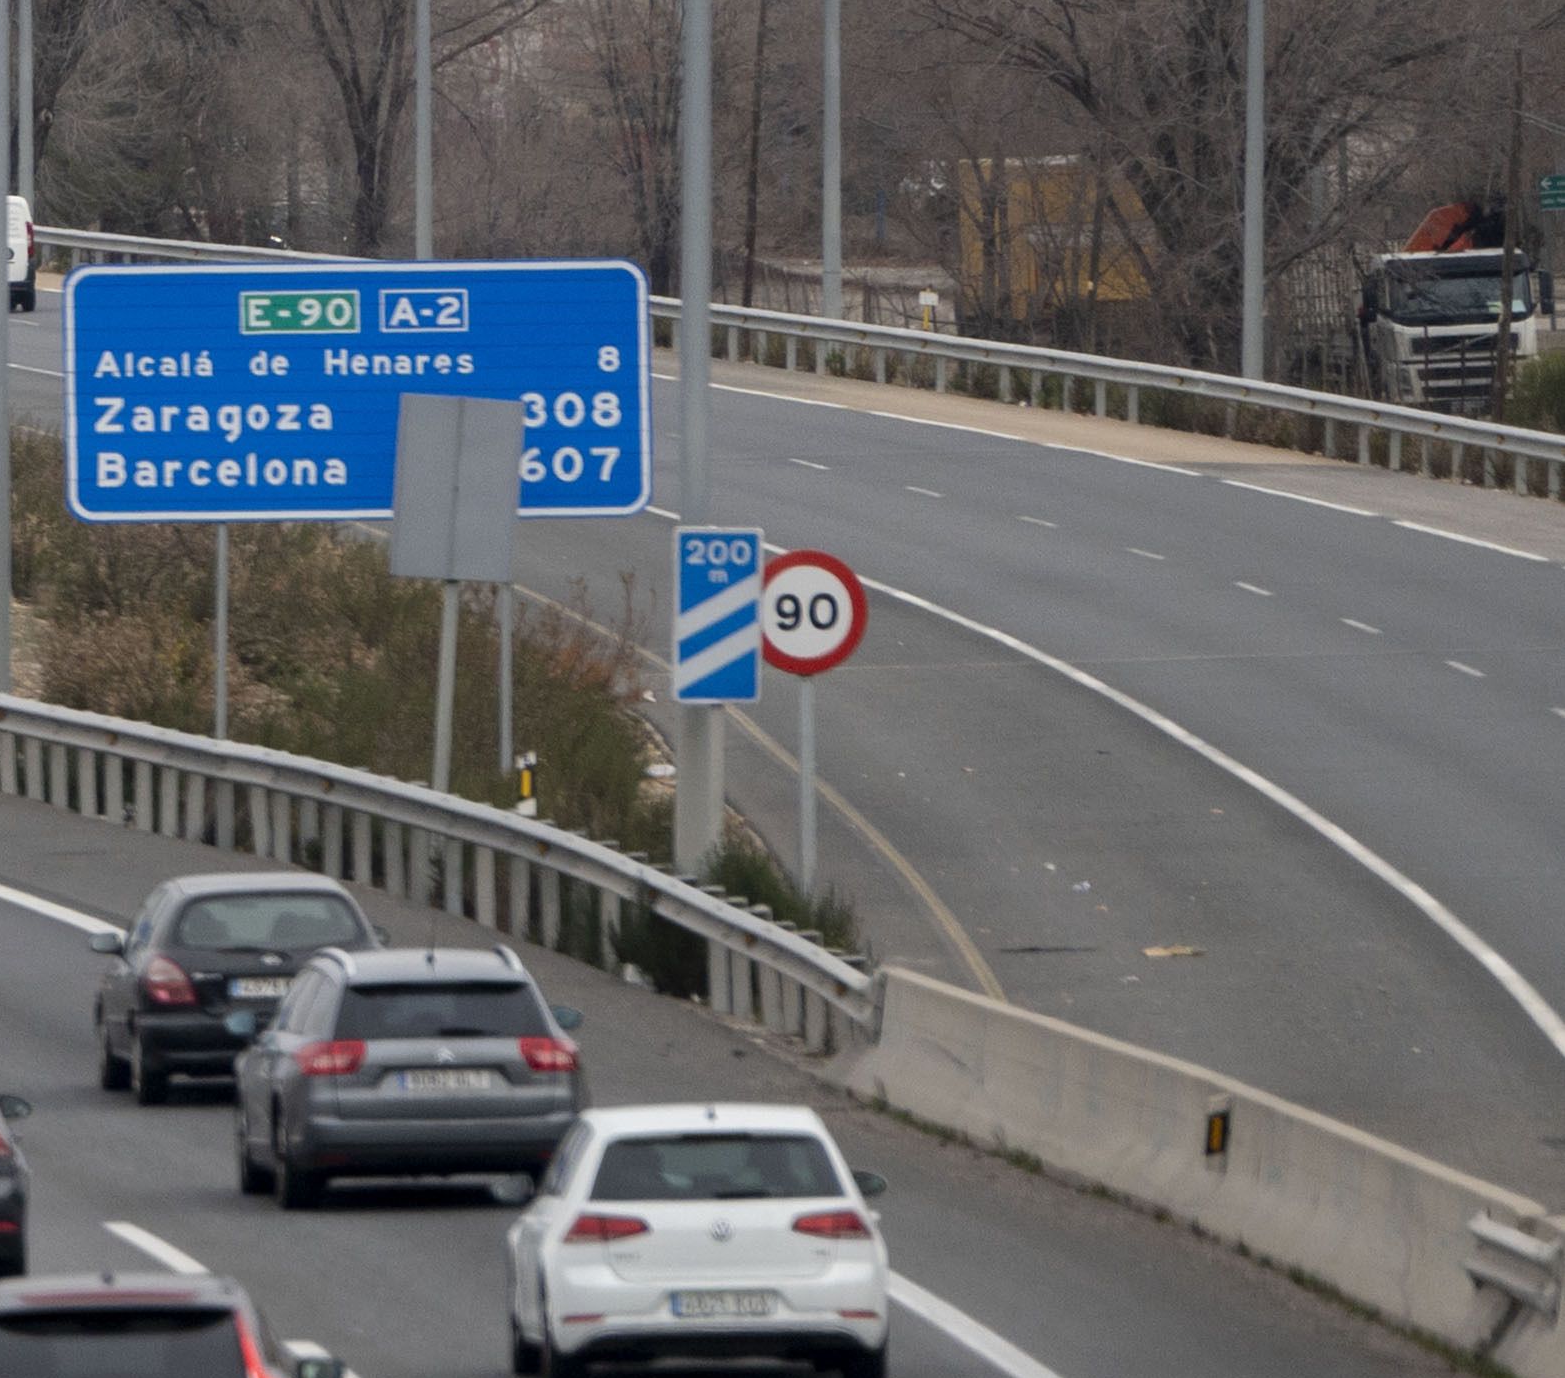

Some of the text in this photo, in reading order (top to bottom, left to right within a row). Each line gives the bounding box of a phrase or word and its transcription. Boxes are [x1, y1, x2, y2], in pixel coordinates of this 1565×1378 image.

[247, 297, 354, 328] E-90
[388, 295, 463, 326] A-2
[94, 344, 622, 379] Alcalá de Henares 8
[94, 391, 623, 443] Zaragoza 308
[96, 445, 622, 489] Barcelona 607
[686, 539, 752, 567] 200
[708, 568, 730, 584] m
[775, 592, 839, 632] 90
